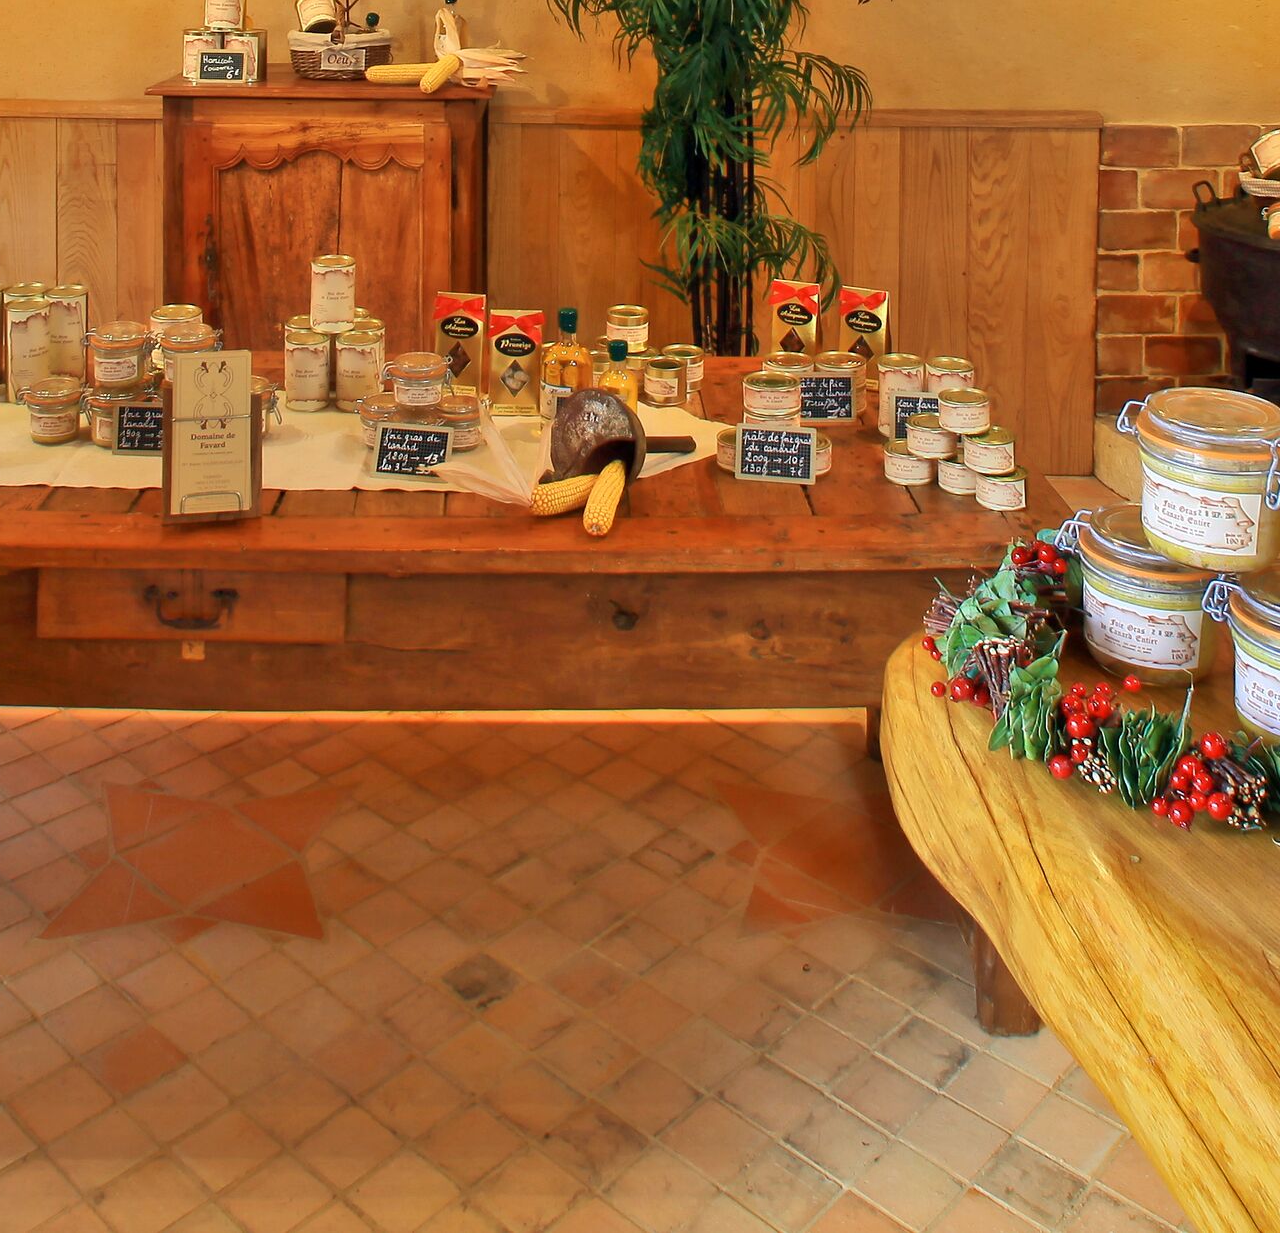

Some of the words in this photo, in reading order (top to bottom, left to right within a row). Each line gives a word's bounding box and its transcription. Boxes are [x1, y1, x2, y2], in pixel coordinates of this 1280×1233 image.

[190, 433, 225, 441] Domaine
[200, 441, 226, 449] Favard
[1162, 499, 1177, 511] Foie
[1161, 507, 1185, 522] Canard
[1187, 517, 1211, 528] Entier
[1251, 682, 1265, 694] Foie
[1251, 691, 1274, 707] Canard
